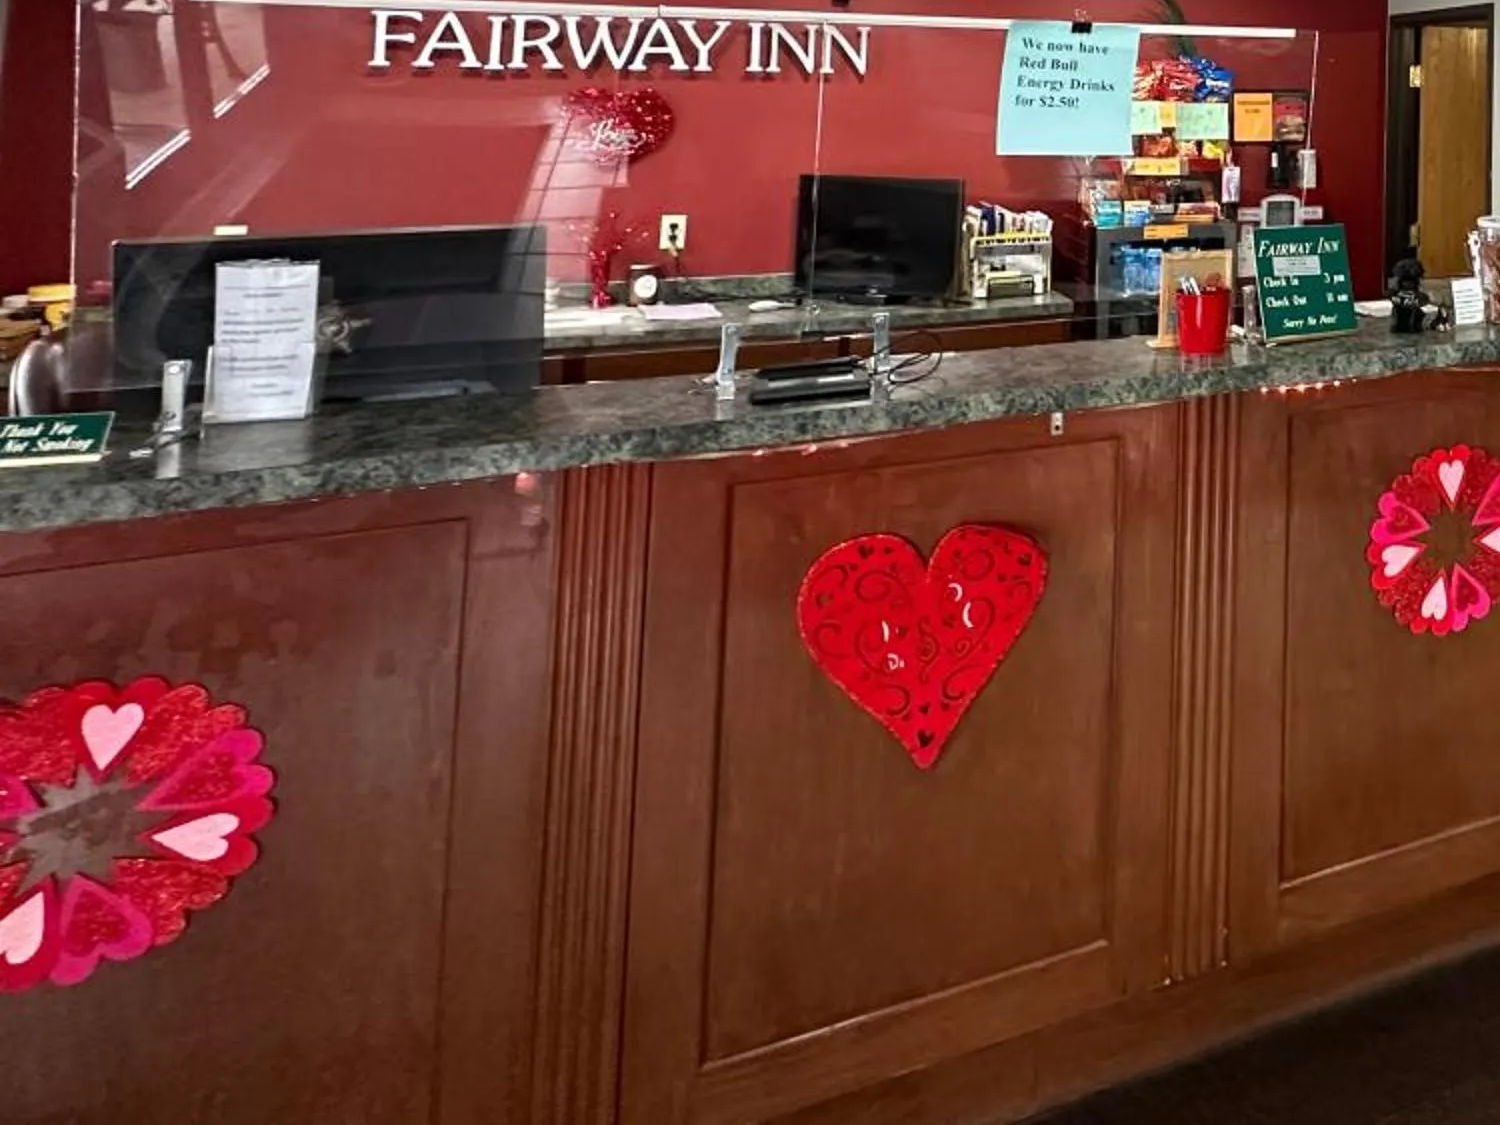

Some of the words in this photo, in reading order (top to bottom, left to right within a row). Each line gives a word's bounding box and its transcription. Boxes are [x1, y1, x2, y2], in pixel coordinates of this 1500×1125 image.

[368, 9, 730, 74] FAIRWAY
[745, 21, 871, 75] INN
[1022, 37, 1044, 51] We
[1047, 42, 1074, 52] now
[1079, 40, 1109, 55] have
[1020, 56, 1046, 69] Red
[1051, 58, 1079, 71] Bull
[1017, 75, 1064, 92] Energy
[1070, 78, 1115, 92] Drinks
[1015, 94, 1036, 107] for
[1039, 95, 1080, 109] $2.50!
[1258, 239, 1314, 258] FAIRWAY
[1317, 236, 1340, 254] INN
[1263, 276, 1287, 288] Check
[1323, 272, 1331, 283] 3
[1265, 295, 1291, 308] Check
[1282, 318, 1305, 328] Sorry
